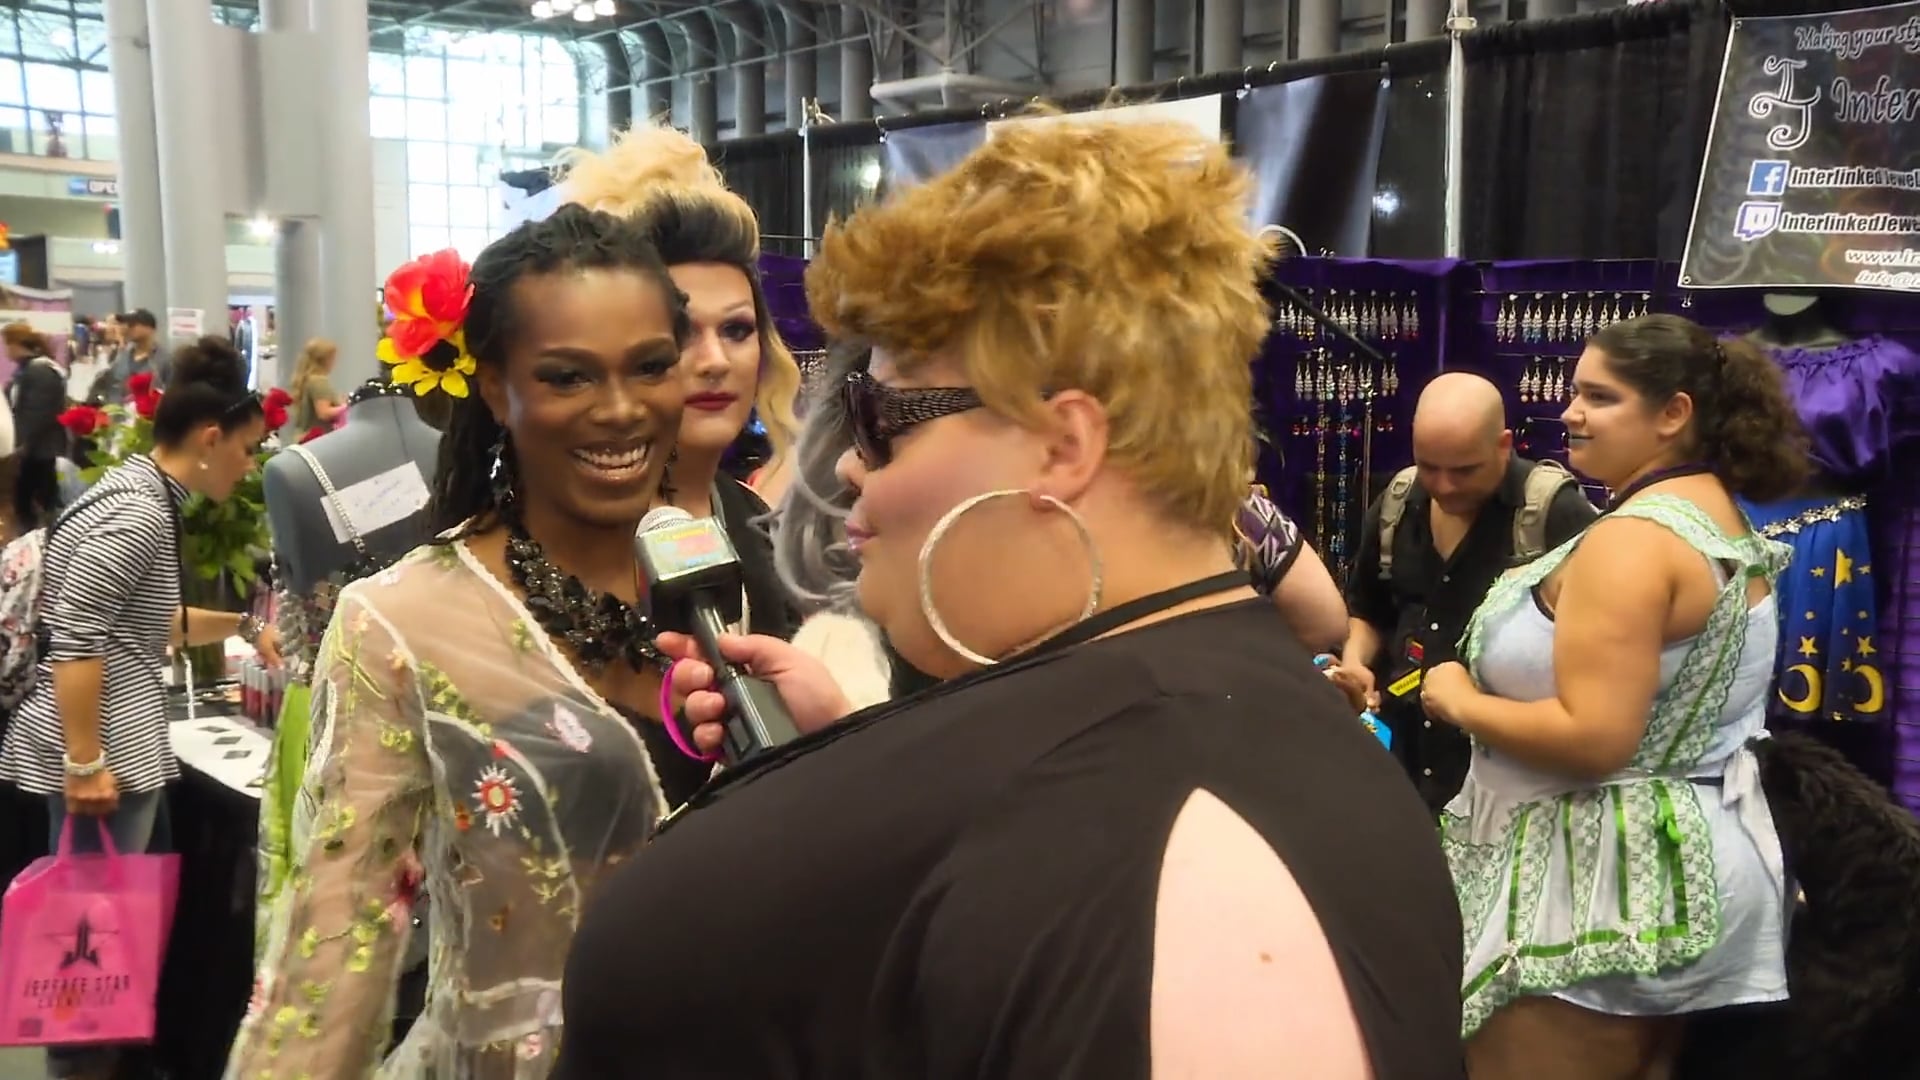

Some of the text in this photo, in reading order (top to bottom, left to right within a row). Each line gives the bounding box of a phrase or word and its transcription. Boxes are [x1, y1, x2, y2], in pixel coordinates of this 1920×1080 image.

[1795, 22, 1850, 59] Making
[1849, 27, 1896, 58] your
[1831, 75, 1920, 122] Inter
